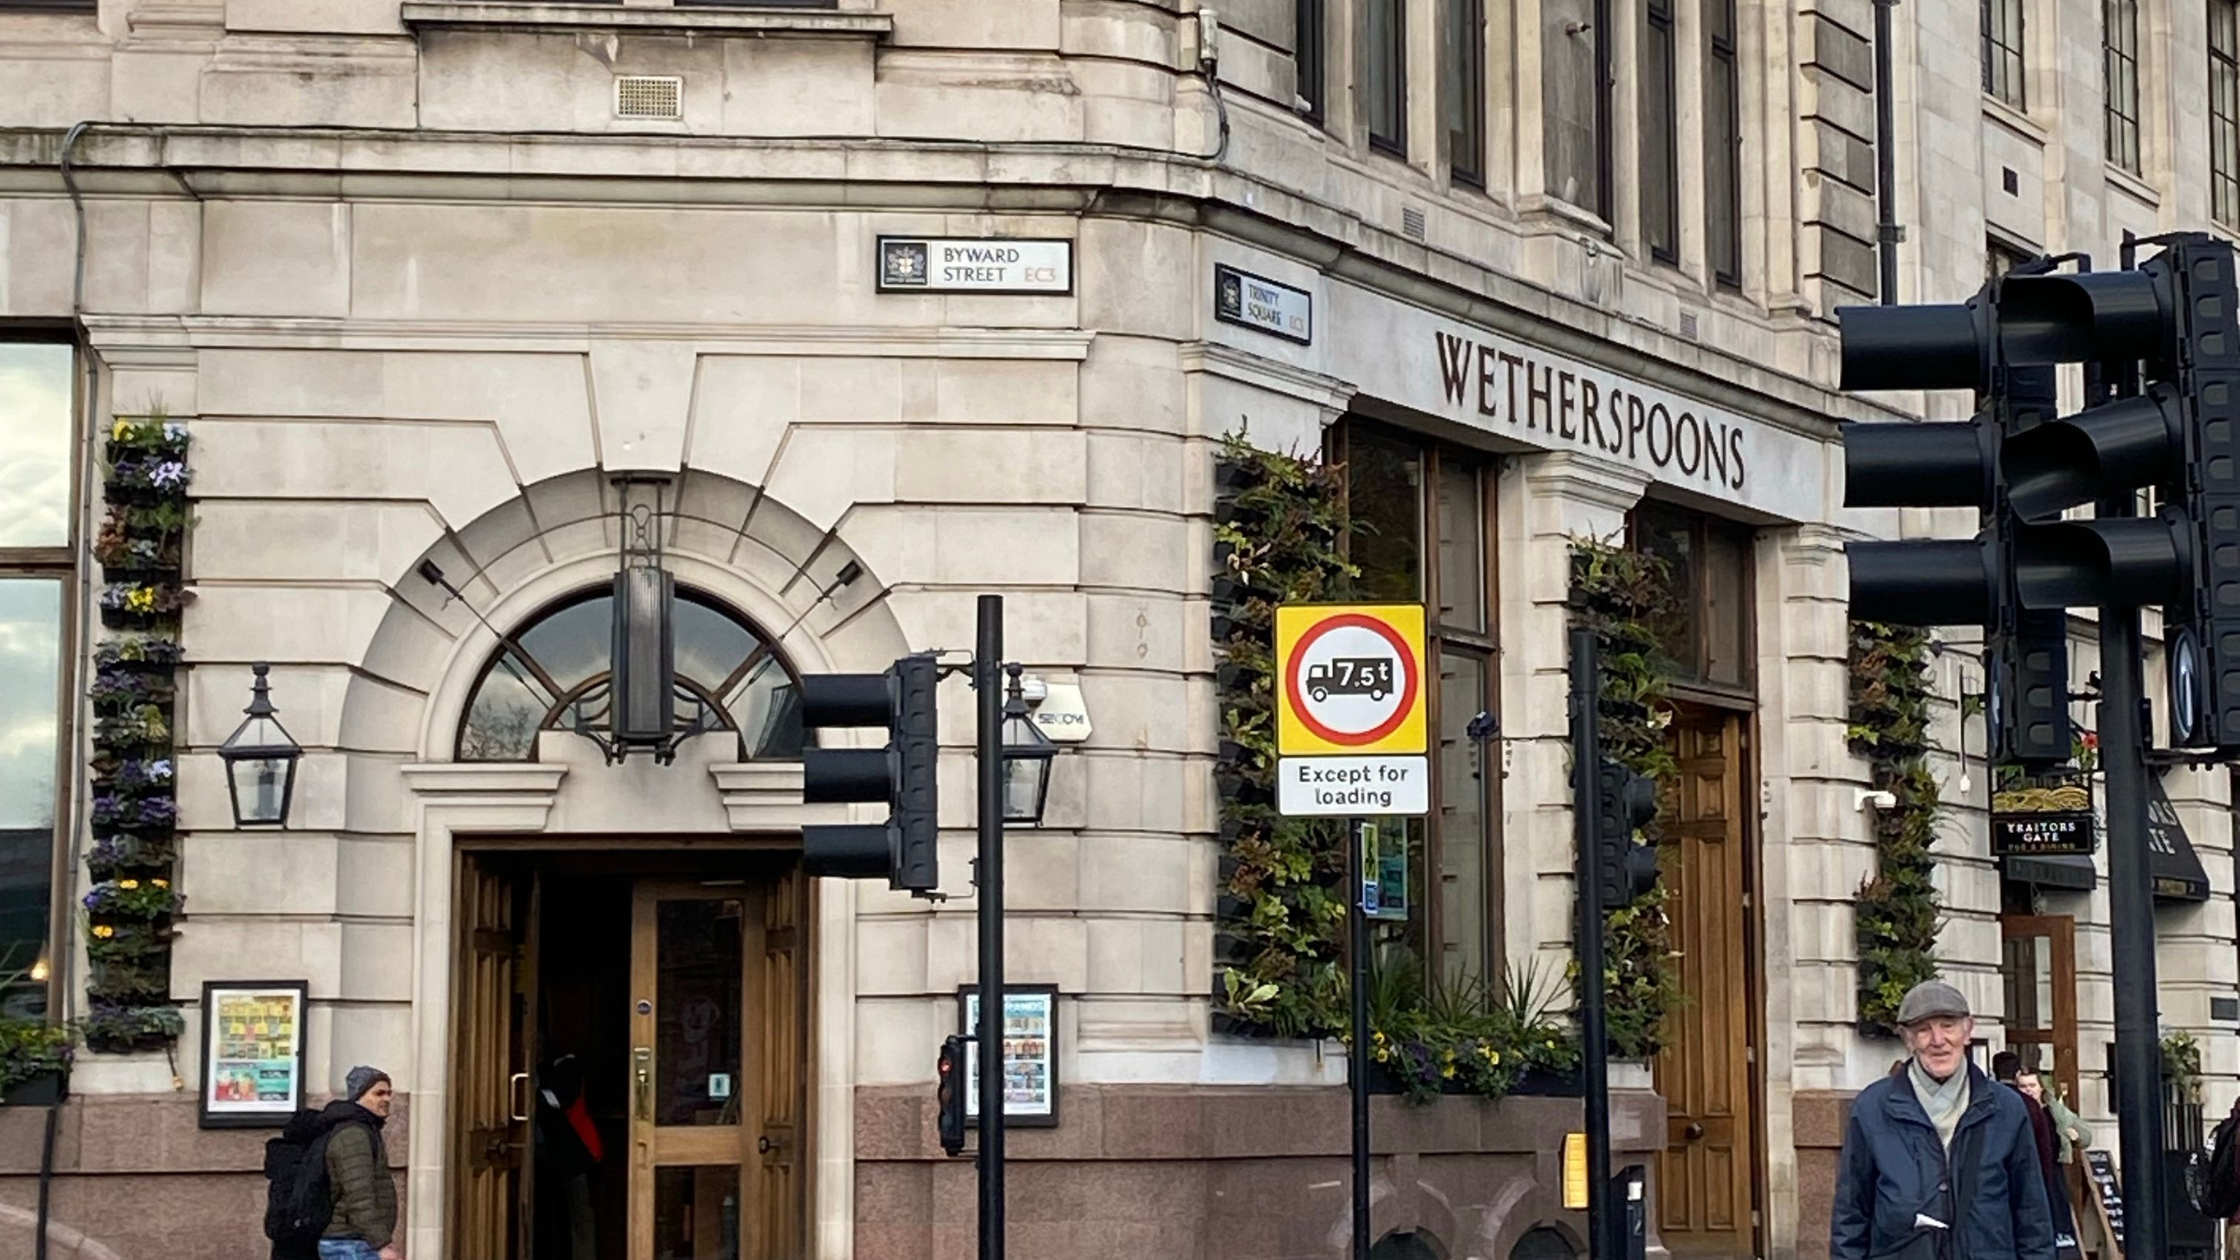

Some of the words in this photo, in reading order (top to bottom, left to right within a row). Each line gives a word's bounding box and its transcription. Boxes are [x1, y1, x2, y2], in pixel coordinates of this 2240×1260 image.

[943, 247, 1020, 263] BYWARD
[943, 266, 1007, 282] STREET
[1024, 267, 1056, 283] EC3
[1248, 283, 1280, 307] TRINITY
[1248, 302, 1282, 326] SQUARE
[1435, 330, 1746, 491] WETHERSPOONS
[1038, 713, 1084, 725] SECOM
[1298, 765, 1371, 785] Except
[1378, 765, 1409, 782] for
[1315, 787, 1392, 807] loading
[2007, 822, 2076, 833] TRAITORS
[2023, 832, 2060, 842] GATE
